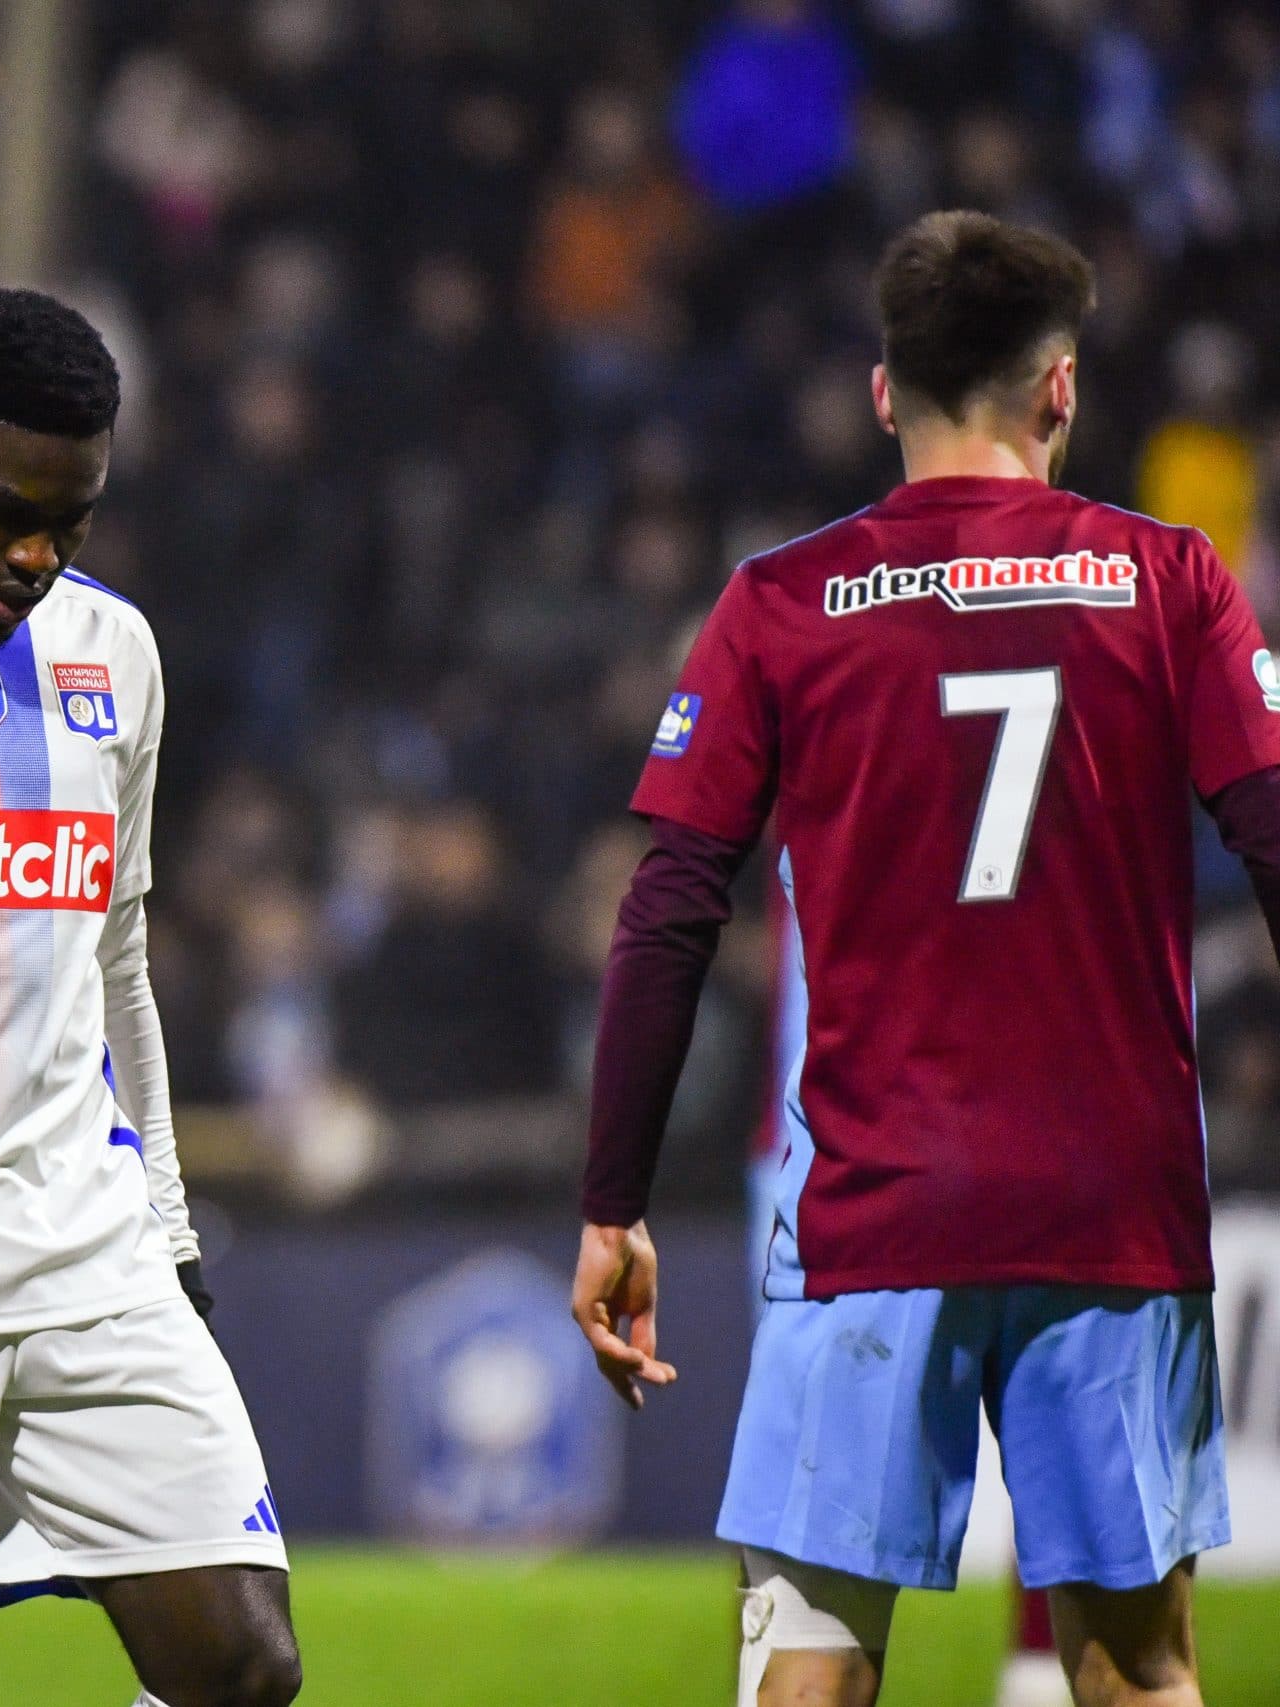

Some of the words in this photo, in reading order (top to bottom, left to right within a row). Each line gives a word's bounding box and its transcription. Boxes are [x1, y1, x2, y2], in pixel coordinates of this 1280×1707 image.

[57, 668, 105, 679] OLYMPIQUE
[60, 678, 107, 688] LYONNAIS
[67, 694, 114, 729] OL
[939, 666, 1062, 903] 7
